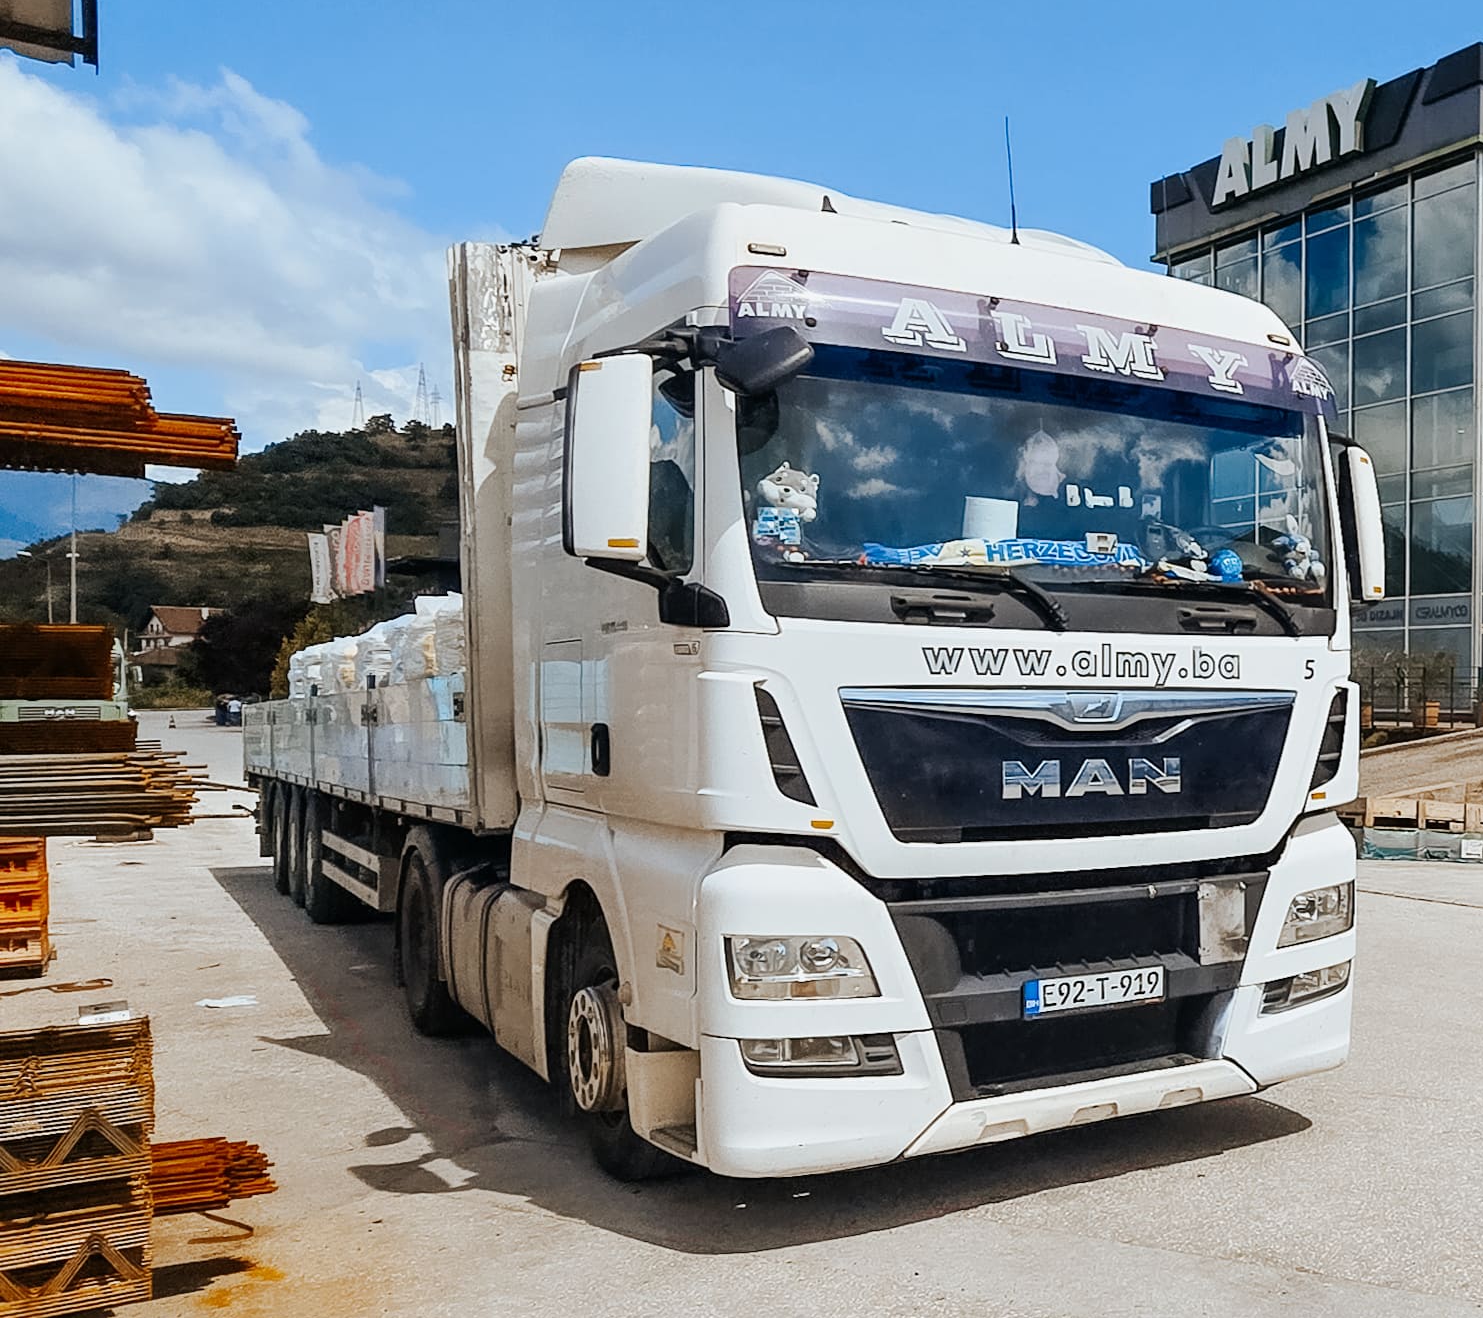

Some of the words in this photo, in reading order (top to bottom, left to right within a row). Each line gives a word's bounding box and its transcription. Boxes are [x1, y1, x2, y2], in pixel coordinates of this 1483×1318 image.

[1212, 78, 1377, 207] ALMY
[737, 302, 806, 320] ALMY
[922, 643, 1241, 687] www.almy.ba
[1303, 658, 1316, 681] 5
[1001, 757, 1183, 800] MAN
[1042, 971, 1160, 1008] E92-T-919
